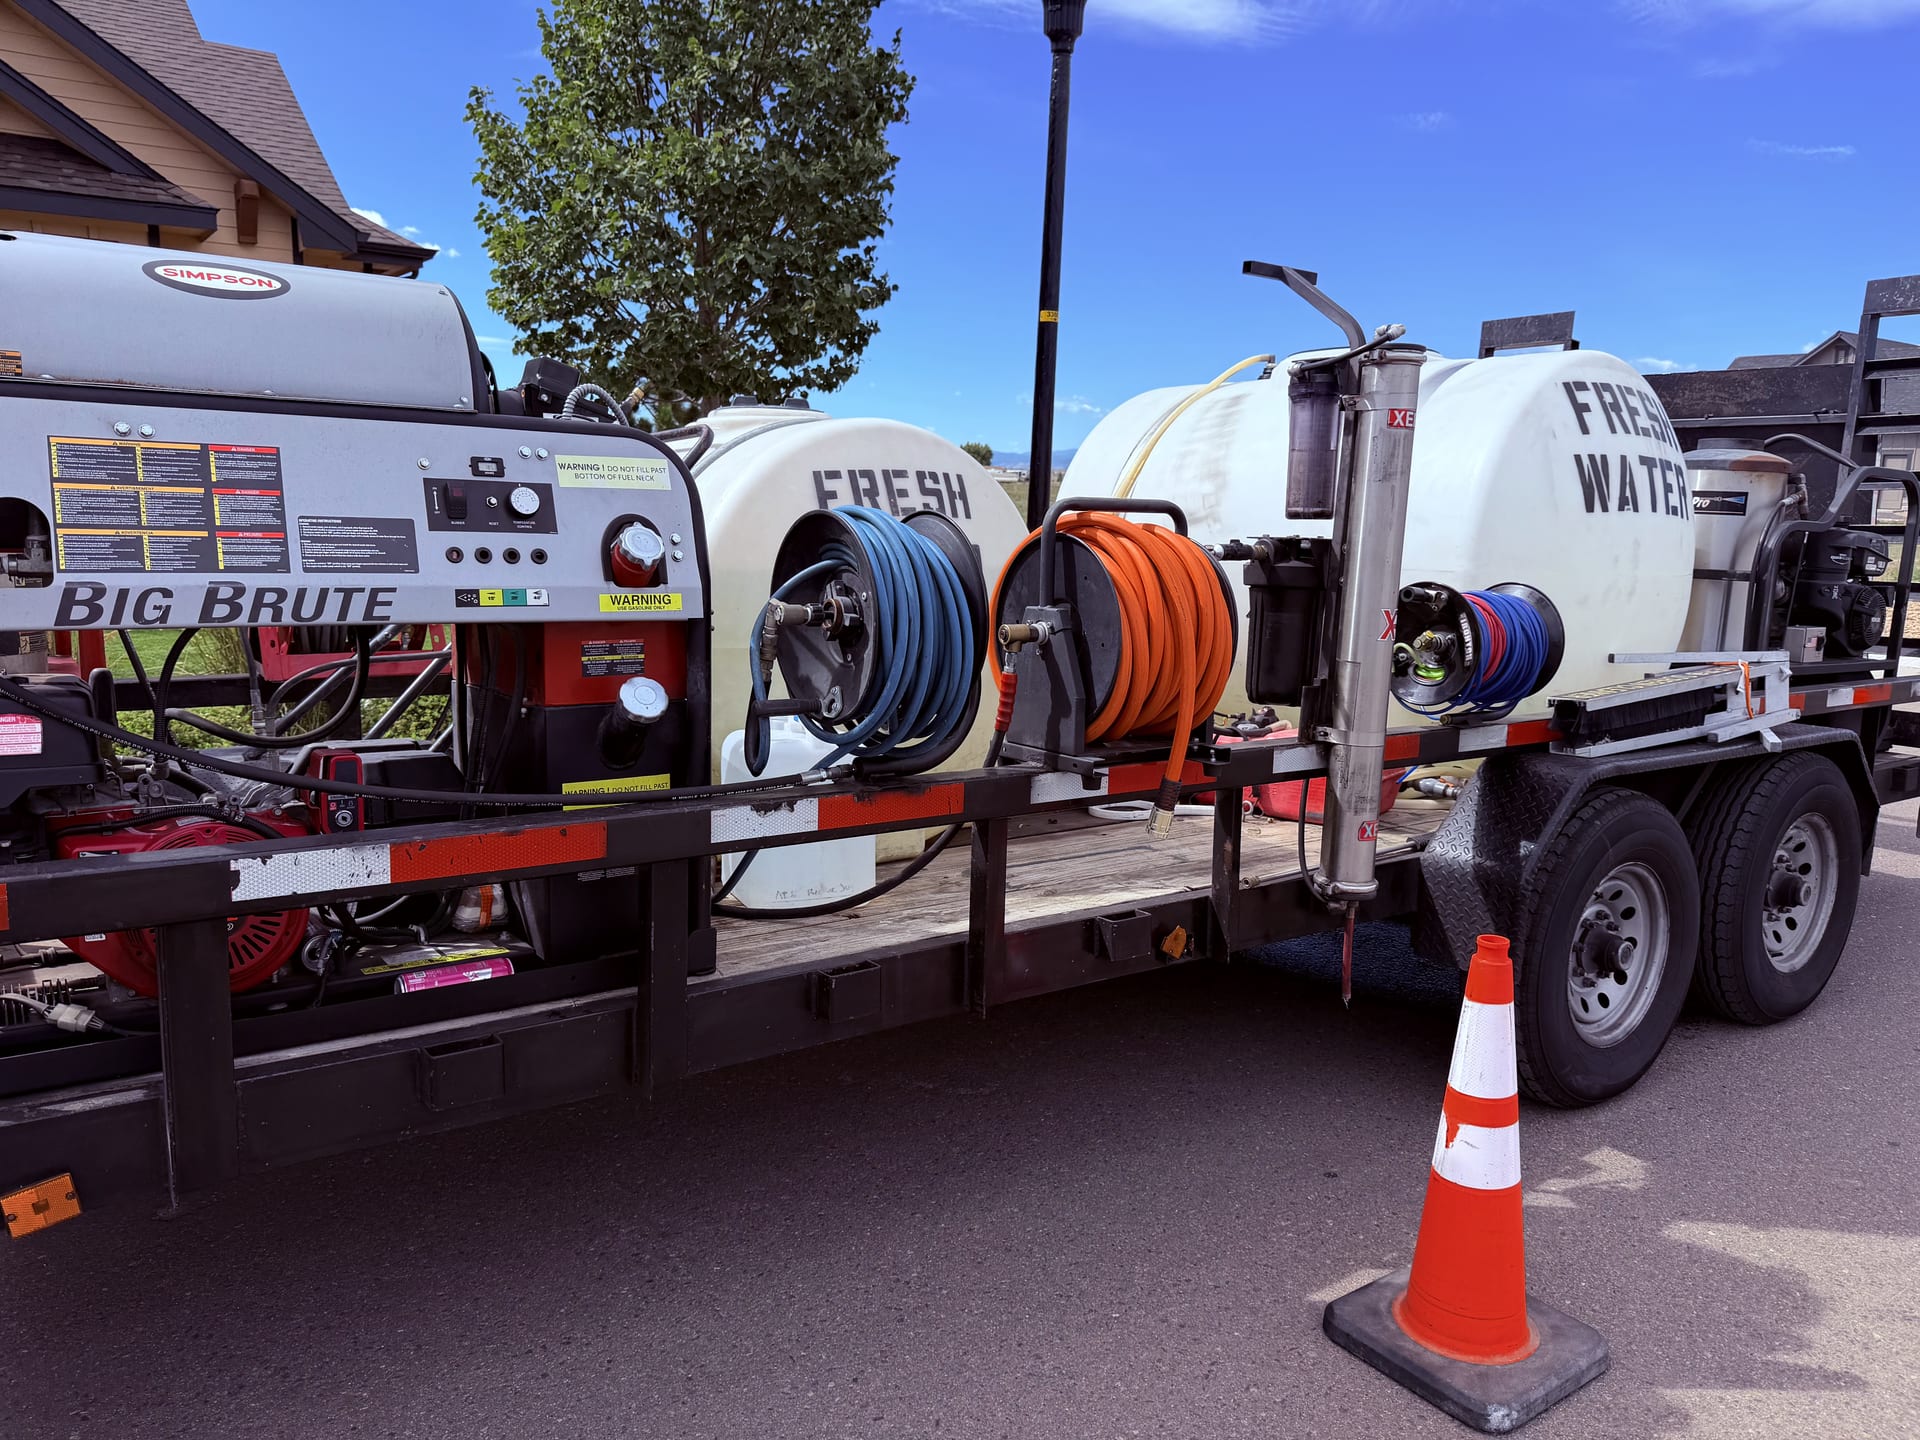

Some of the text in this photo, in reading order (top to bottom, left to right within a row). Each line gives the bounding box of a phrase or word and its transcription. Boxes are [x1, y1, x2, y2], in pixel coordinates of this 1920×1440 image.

[163, 268, 273, 288] SIMPSON
[1562, 381, 1682, 453] FRESH
[558, 463, 600, 472] WARNING
[607, 473, 616, 481] OF
[812, 469, 972, 520] FRESH
[1573, 453, 1690, 521] WATER
[53, 580, 398, 627] BIG BRUTE
[610, 594, 672, 606] WARNING
